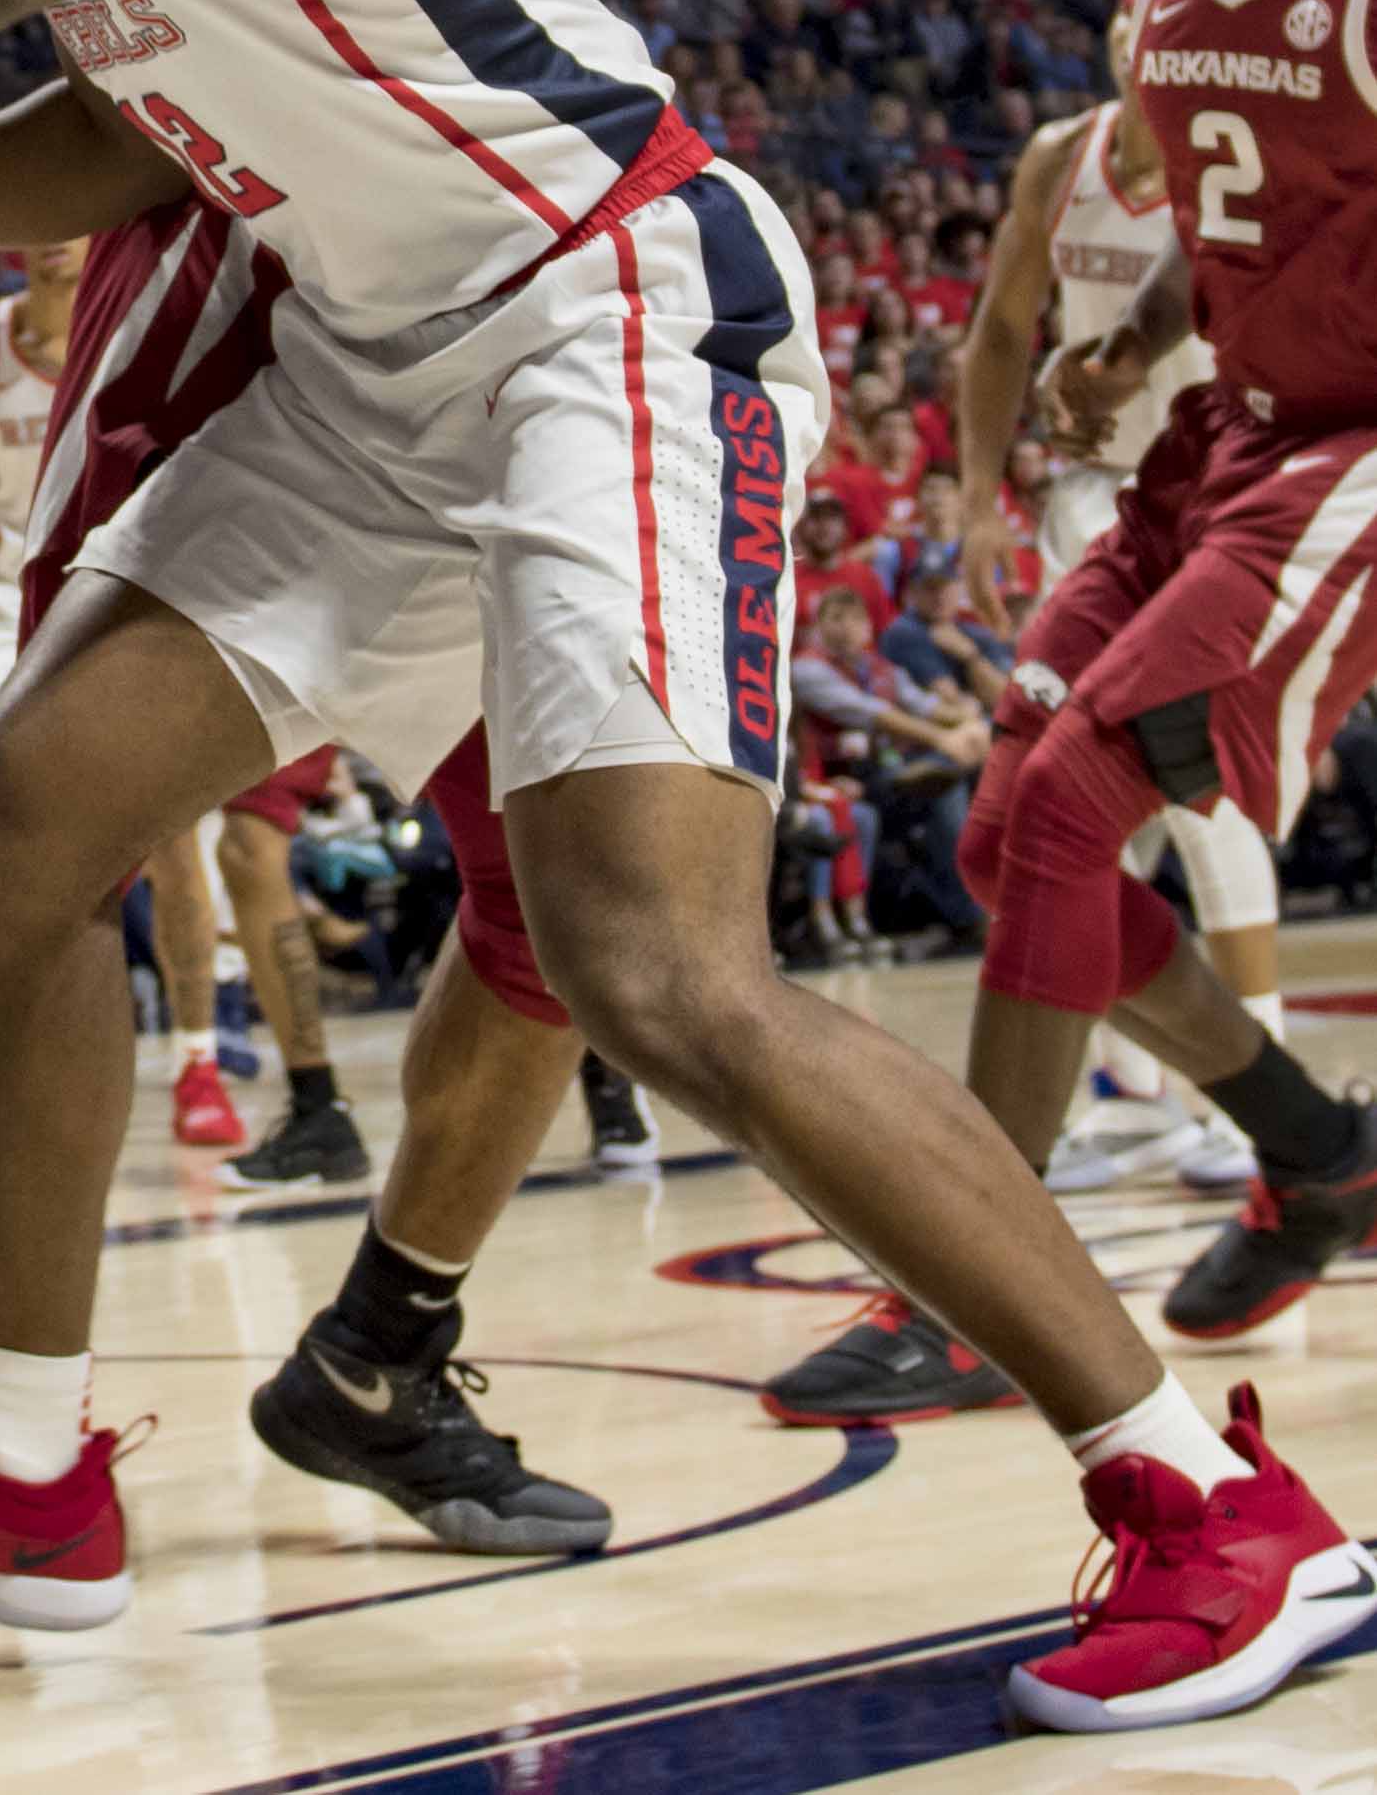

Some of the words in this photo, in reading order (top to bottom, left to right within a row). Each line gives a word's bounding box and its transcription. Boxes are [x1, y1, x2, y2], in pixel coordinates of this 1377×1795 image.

[1139, 50, 1323, 102] ARKANSAS
[1190, 109, 1265, 246] 2
[723, 392, 784, 572] MISS
[736, 585, 780, 742] OLE
